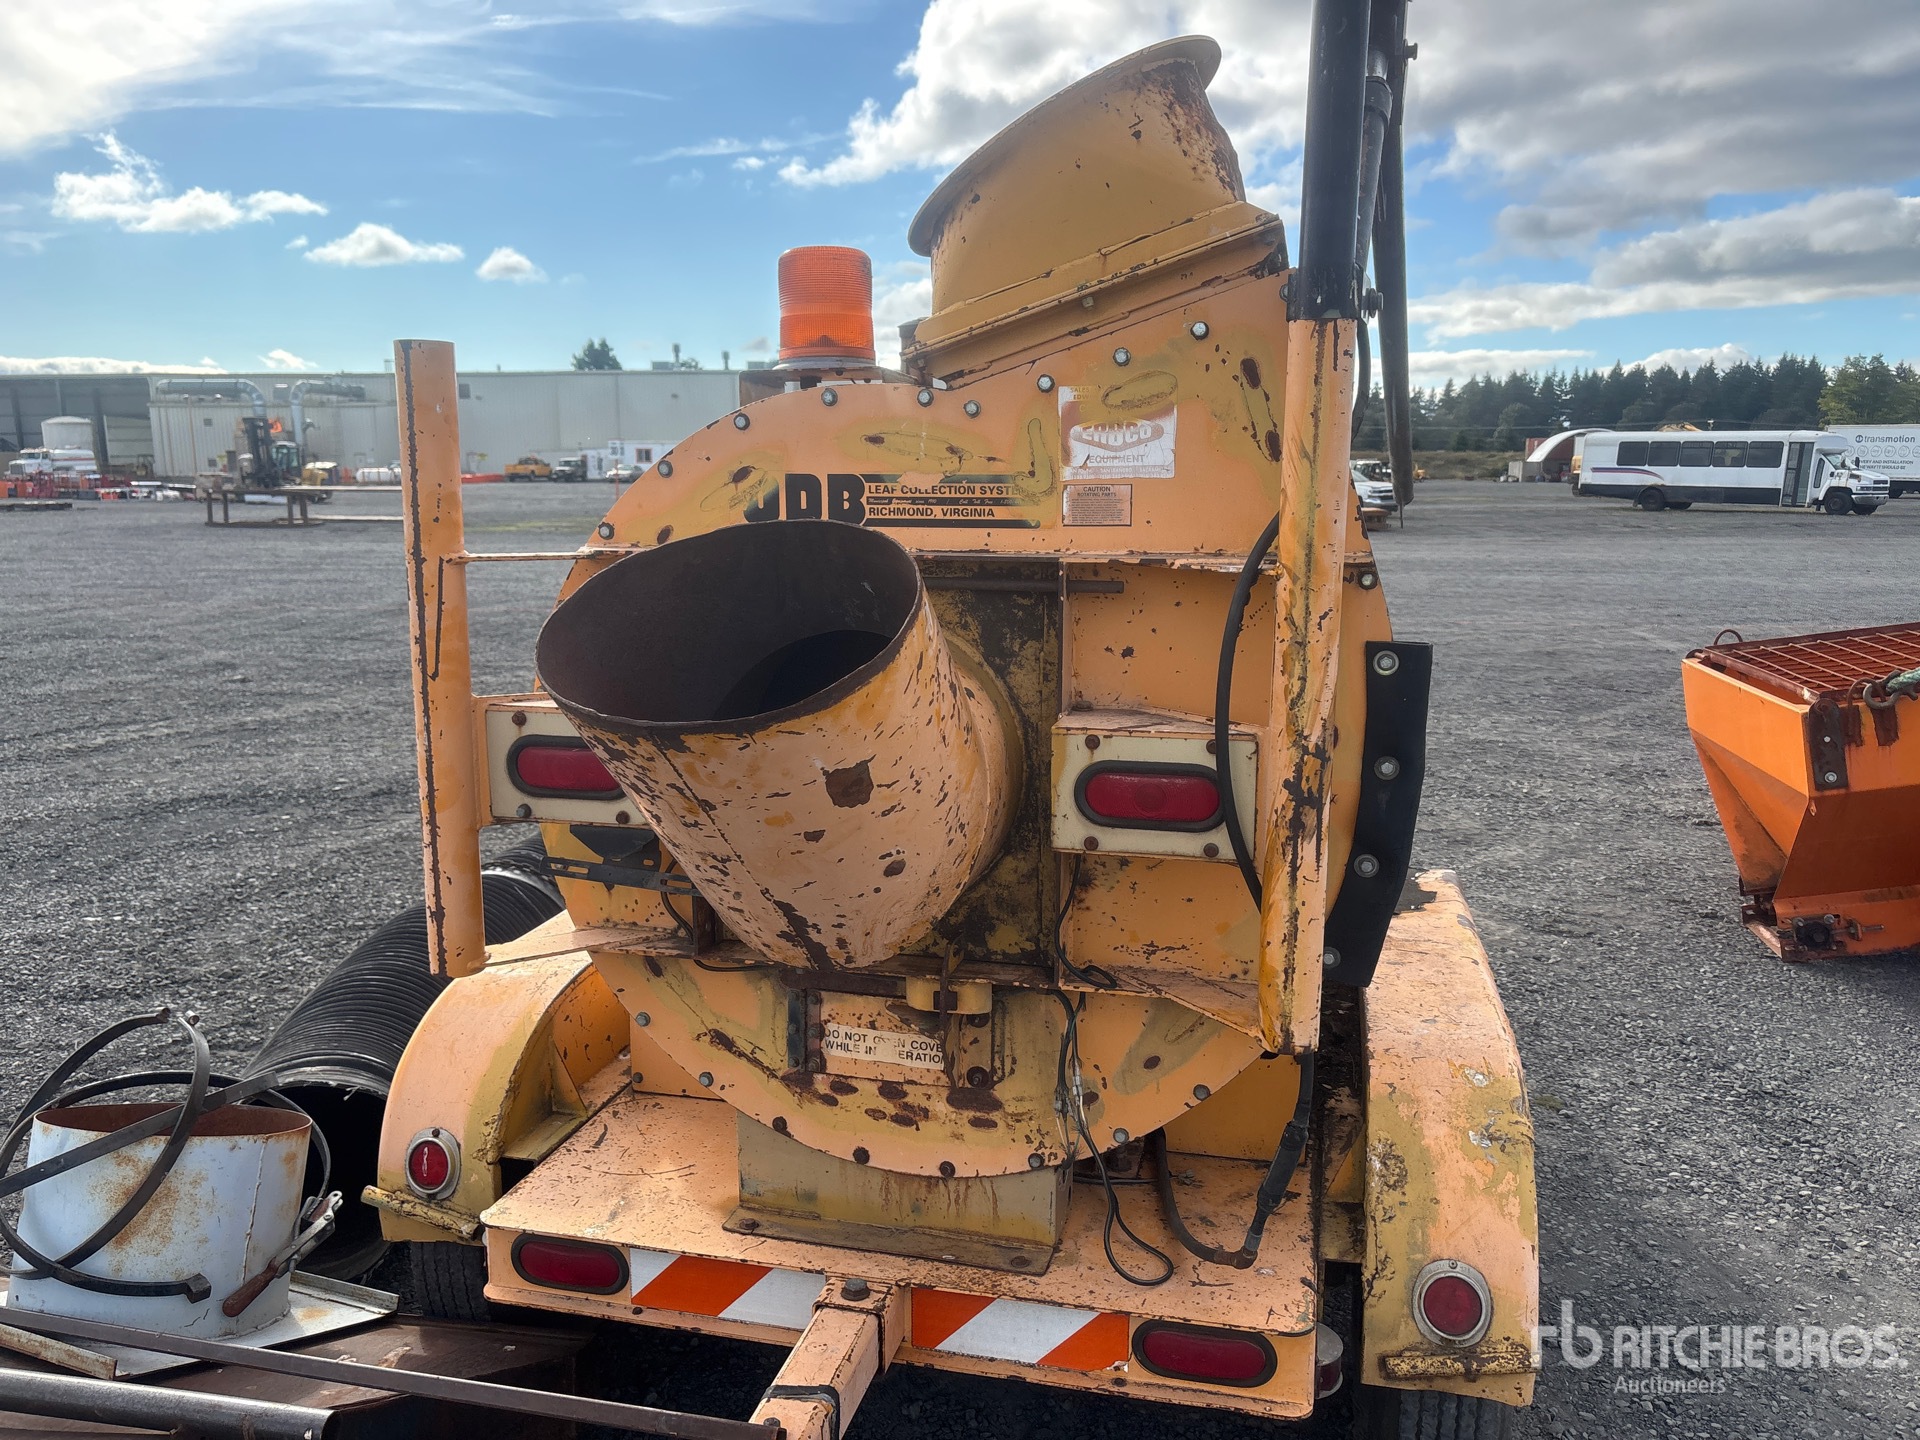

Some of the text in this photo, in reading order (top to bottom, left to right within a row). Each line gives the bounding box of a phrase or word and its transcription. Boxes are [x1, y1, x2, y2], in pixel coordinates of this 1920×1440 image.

[1864, 435, 1916, 443] transmotion
[1089, 454, 1146, 464] EQUIPMENT
[868, 484, 1021, 496] LEAF COLLECTION SYSTE
[868, 506, 995, 518] RICHMOND, VIRGINIA
[825, 1039, 861, 1054] WHILE
[844, 1031, 869, 1044] NOT
[910, 1040, 942, 1053] COVE
